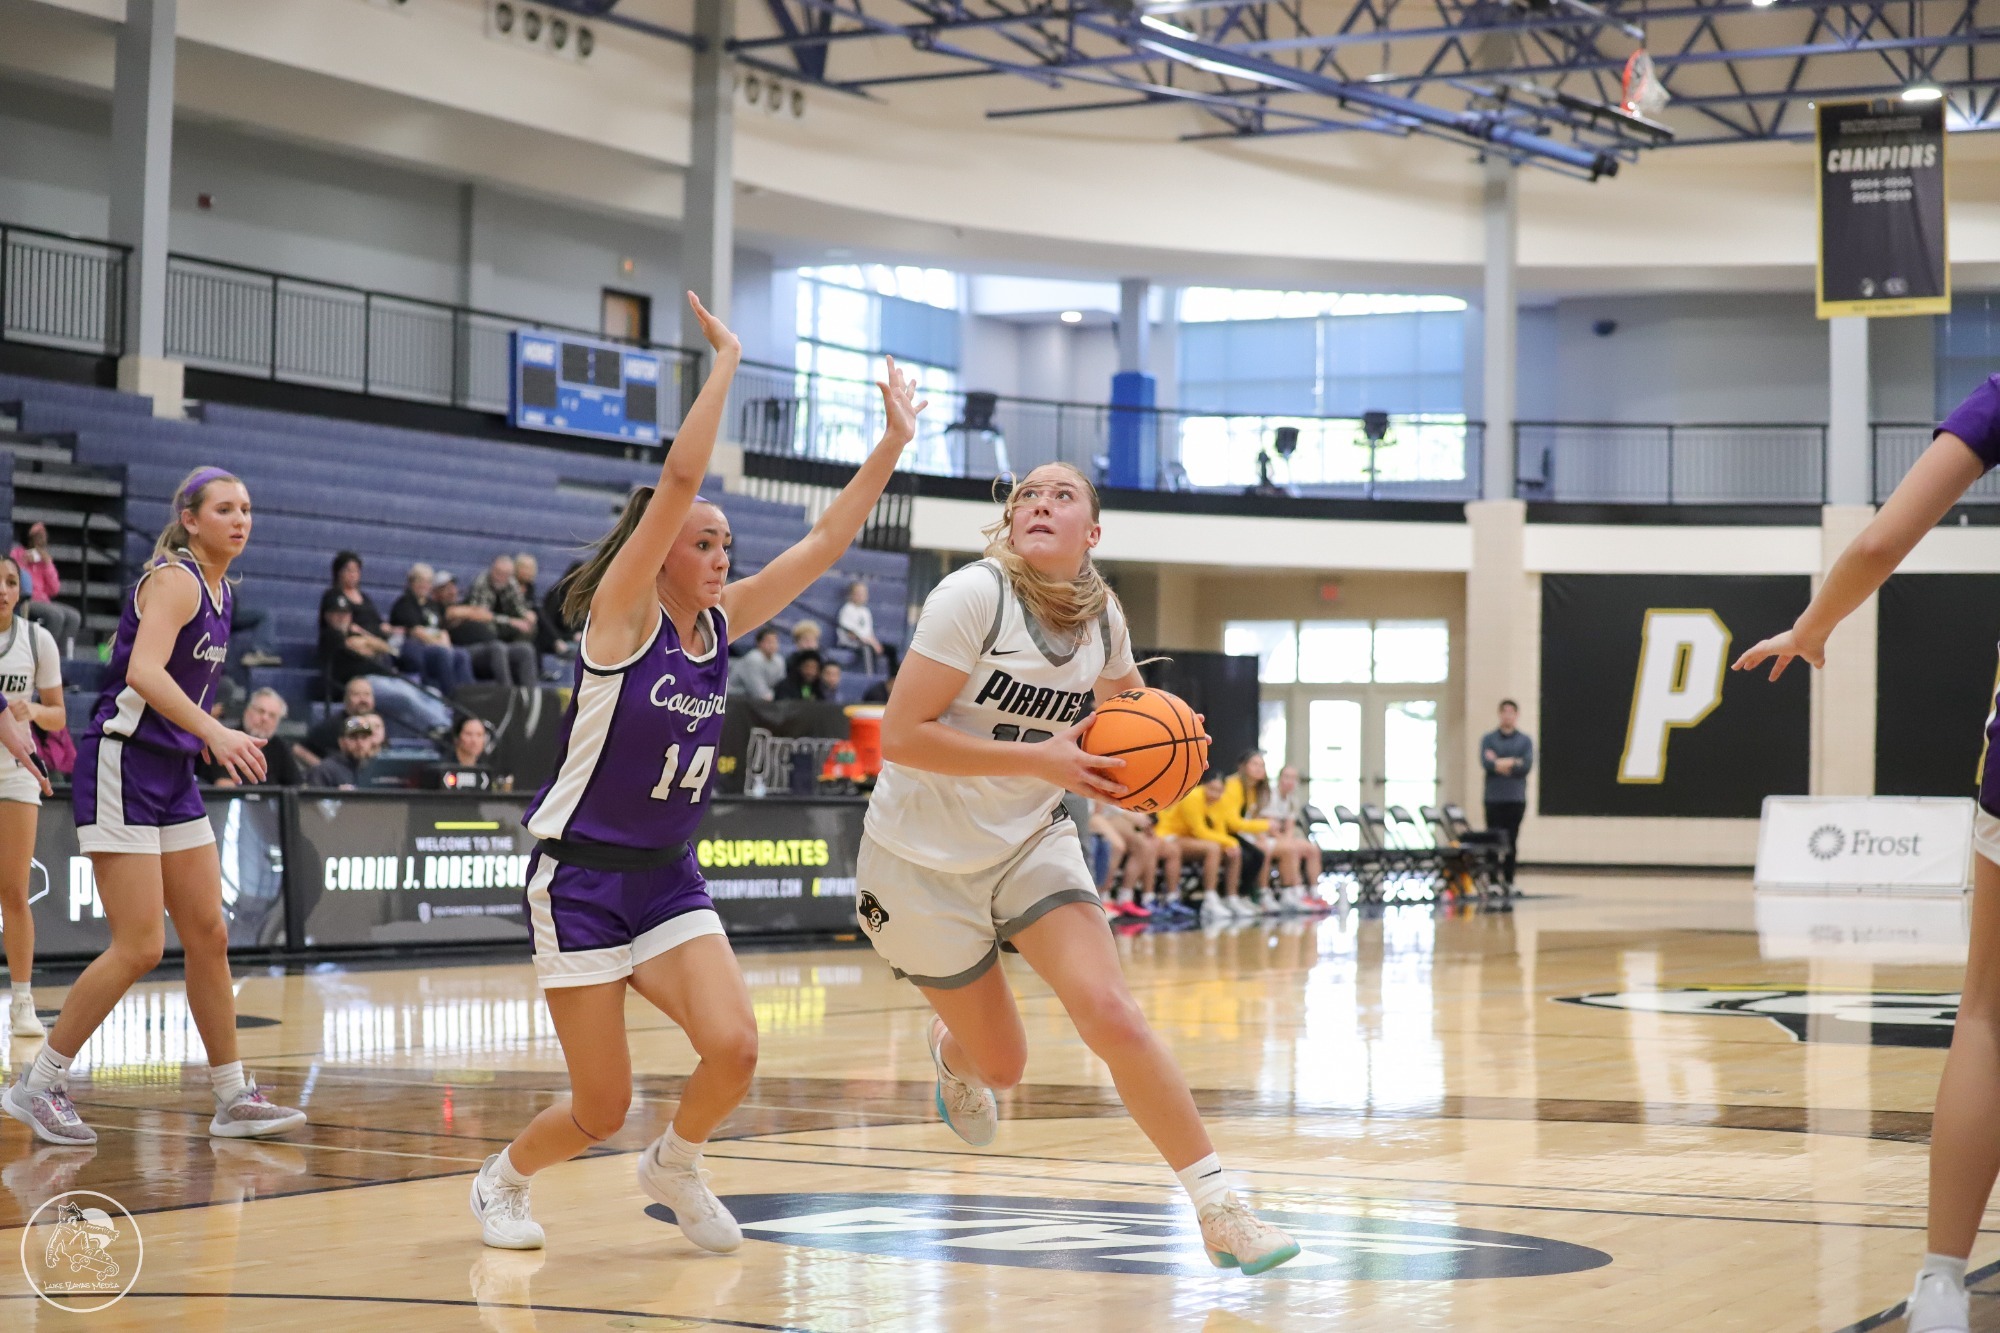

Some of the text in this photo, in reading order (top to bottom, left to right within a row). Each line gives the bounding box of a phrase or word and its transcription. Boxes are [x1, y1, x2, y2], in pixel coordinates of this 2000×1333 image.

[1827, 144, 1937, 173] CHAMPIONS
[1617, 608, 1733, 784] P
[650, 743, 716, 804] 14
[416, 836, 514, 851] WELCOME TO THE
[697, 838, 830, 868] @SUPIRATES
[1851, 828, 1923, 857] Frost
[402, 855, 420, 889] J.
